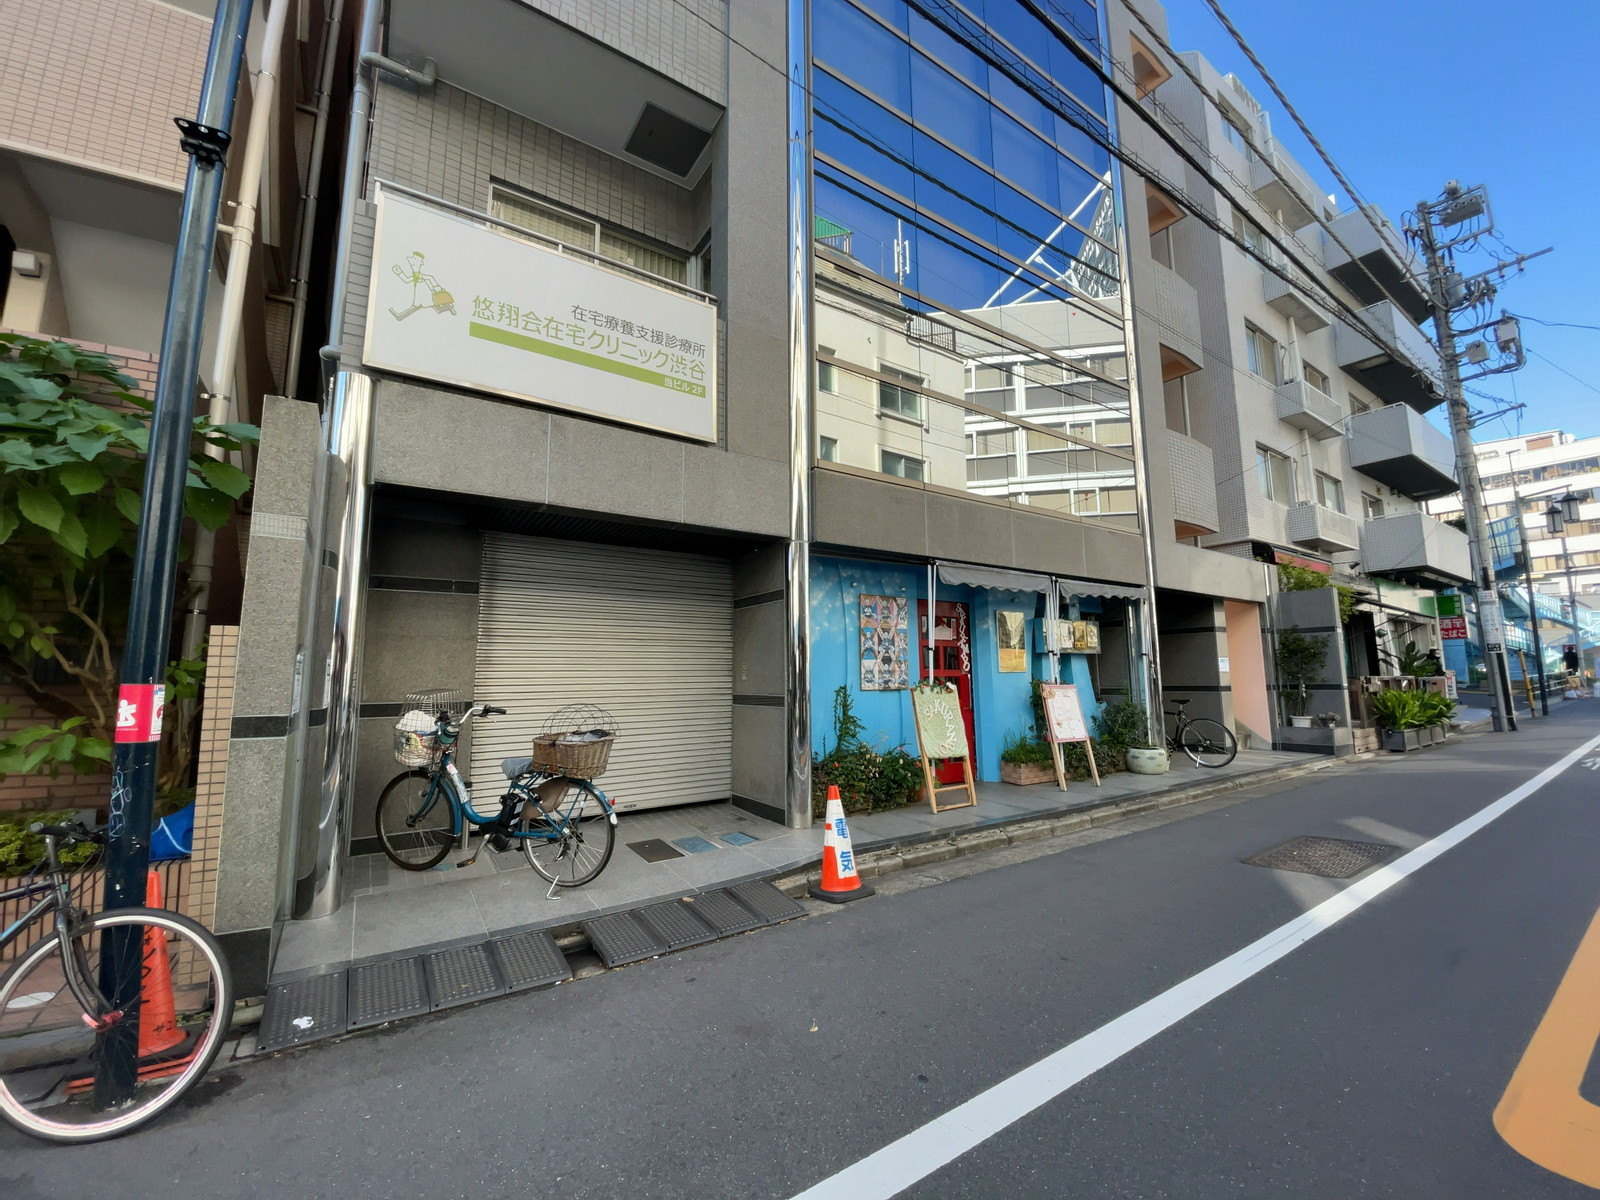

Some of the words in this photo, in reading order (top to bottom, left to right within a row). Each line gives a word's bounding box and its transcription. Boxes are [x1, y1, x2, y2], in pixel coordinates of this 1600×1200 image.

[472, 296, 706, 382] 悠翔会在宅クリニック渋谷
[572, 305, 706, 358] 在宅療養支援診療所
[664, 377, 690, 392] 当ビル
[692, 386, 704, 395] 2F
[924, 699, 957, 754] SAKURANBO
